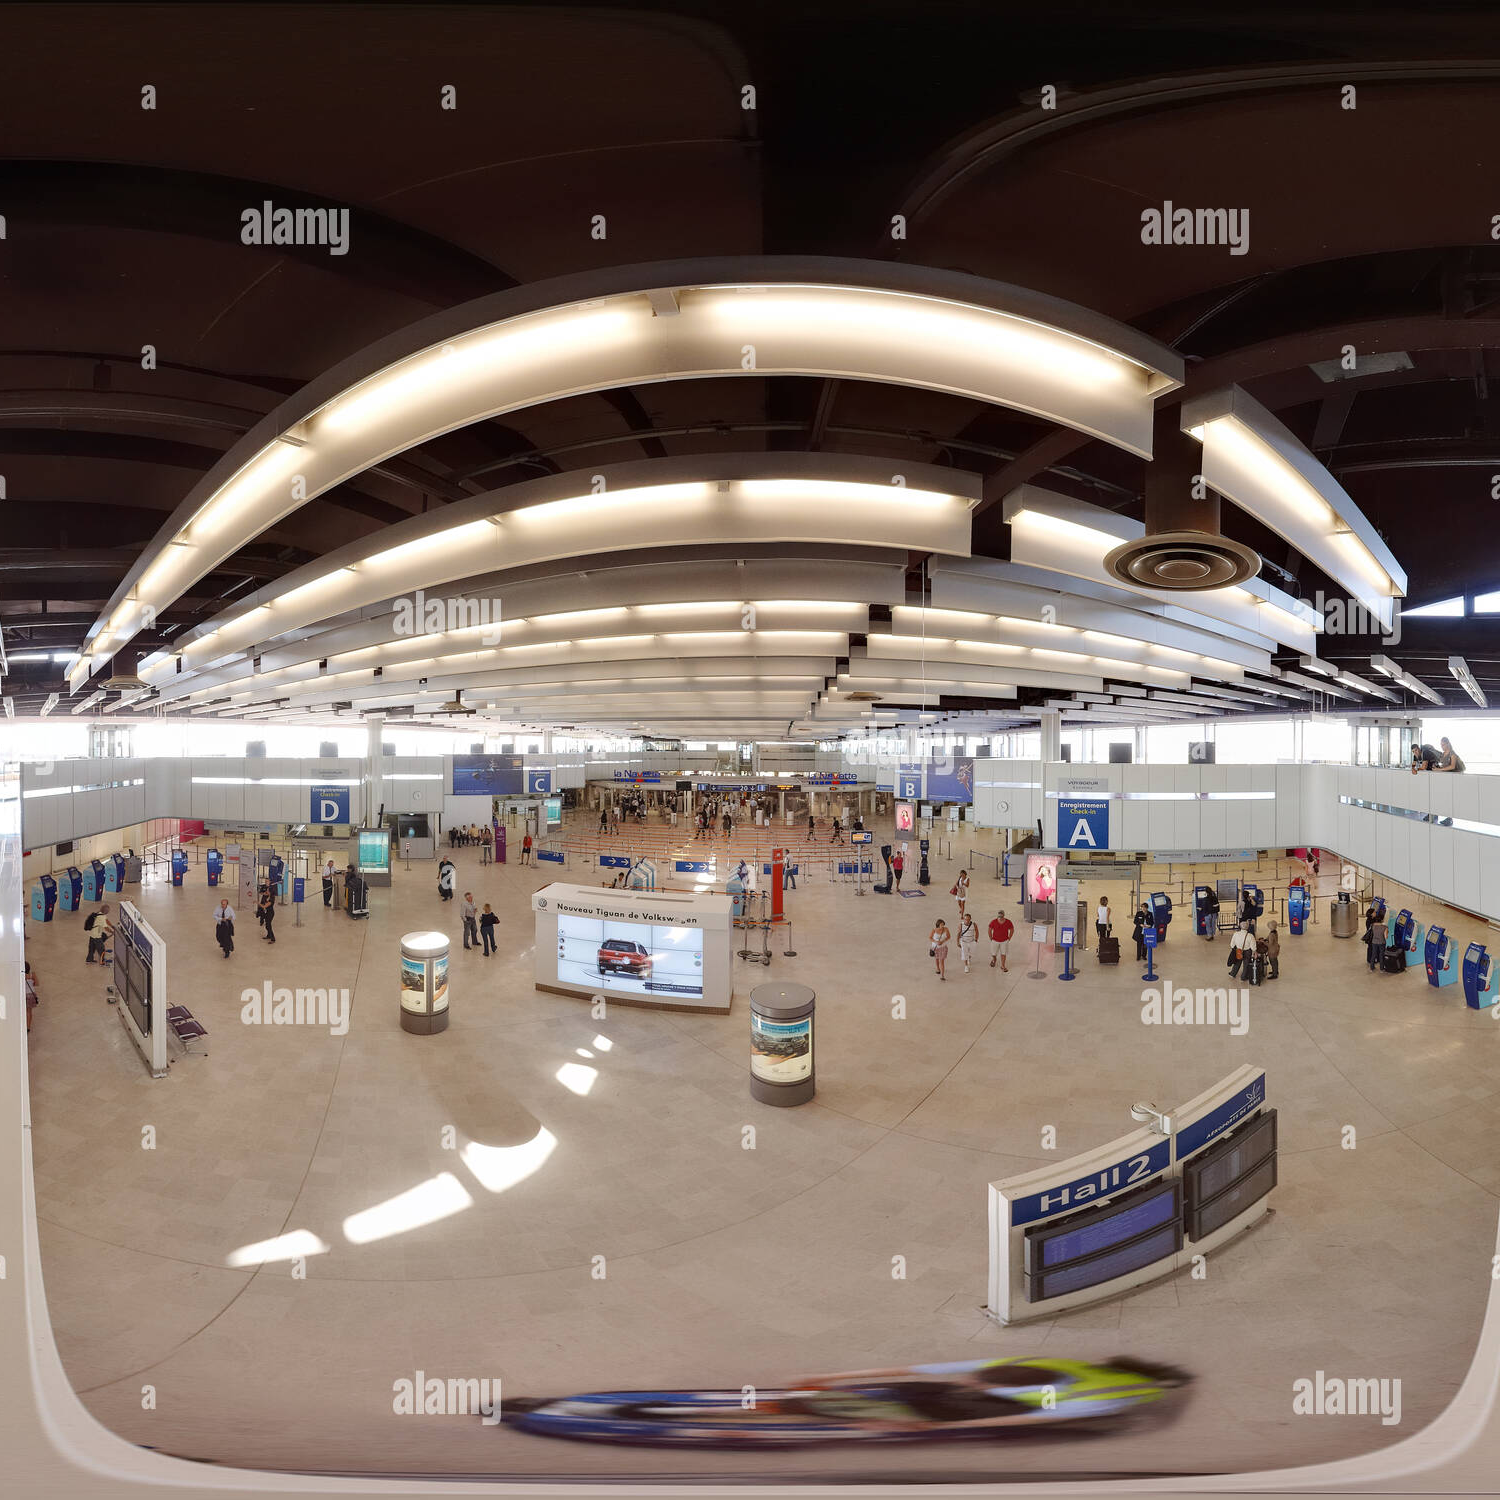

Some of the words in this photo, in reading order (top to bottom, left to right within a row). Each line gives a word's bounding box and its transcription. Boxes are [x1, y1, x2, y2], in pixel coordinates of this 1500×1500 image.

[534, 778, 545, 792] C
[905, 782, 915, 797] B
[320, 799, 339, 821] D
[1068, 818, 1097, 846] A
[557, 903, 593, 914] Nouveau
[596, 908, 625, 918] Tiguan
[628, 911, 639, 919] de
[642, 913, 697, 924] Volkswen
[1041, 1167, 1119, 1212] Hall
[1127, 1155, 1151, 1183] 2
